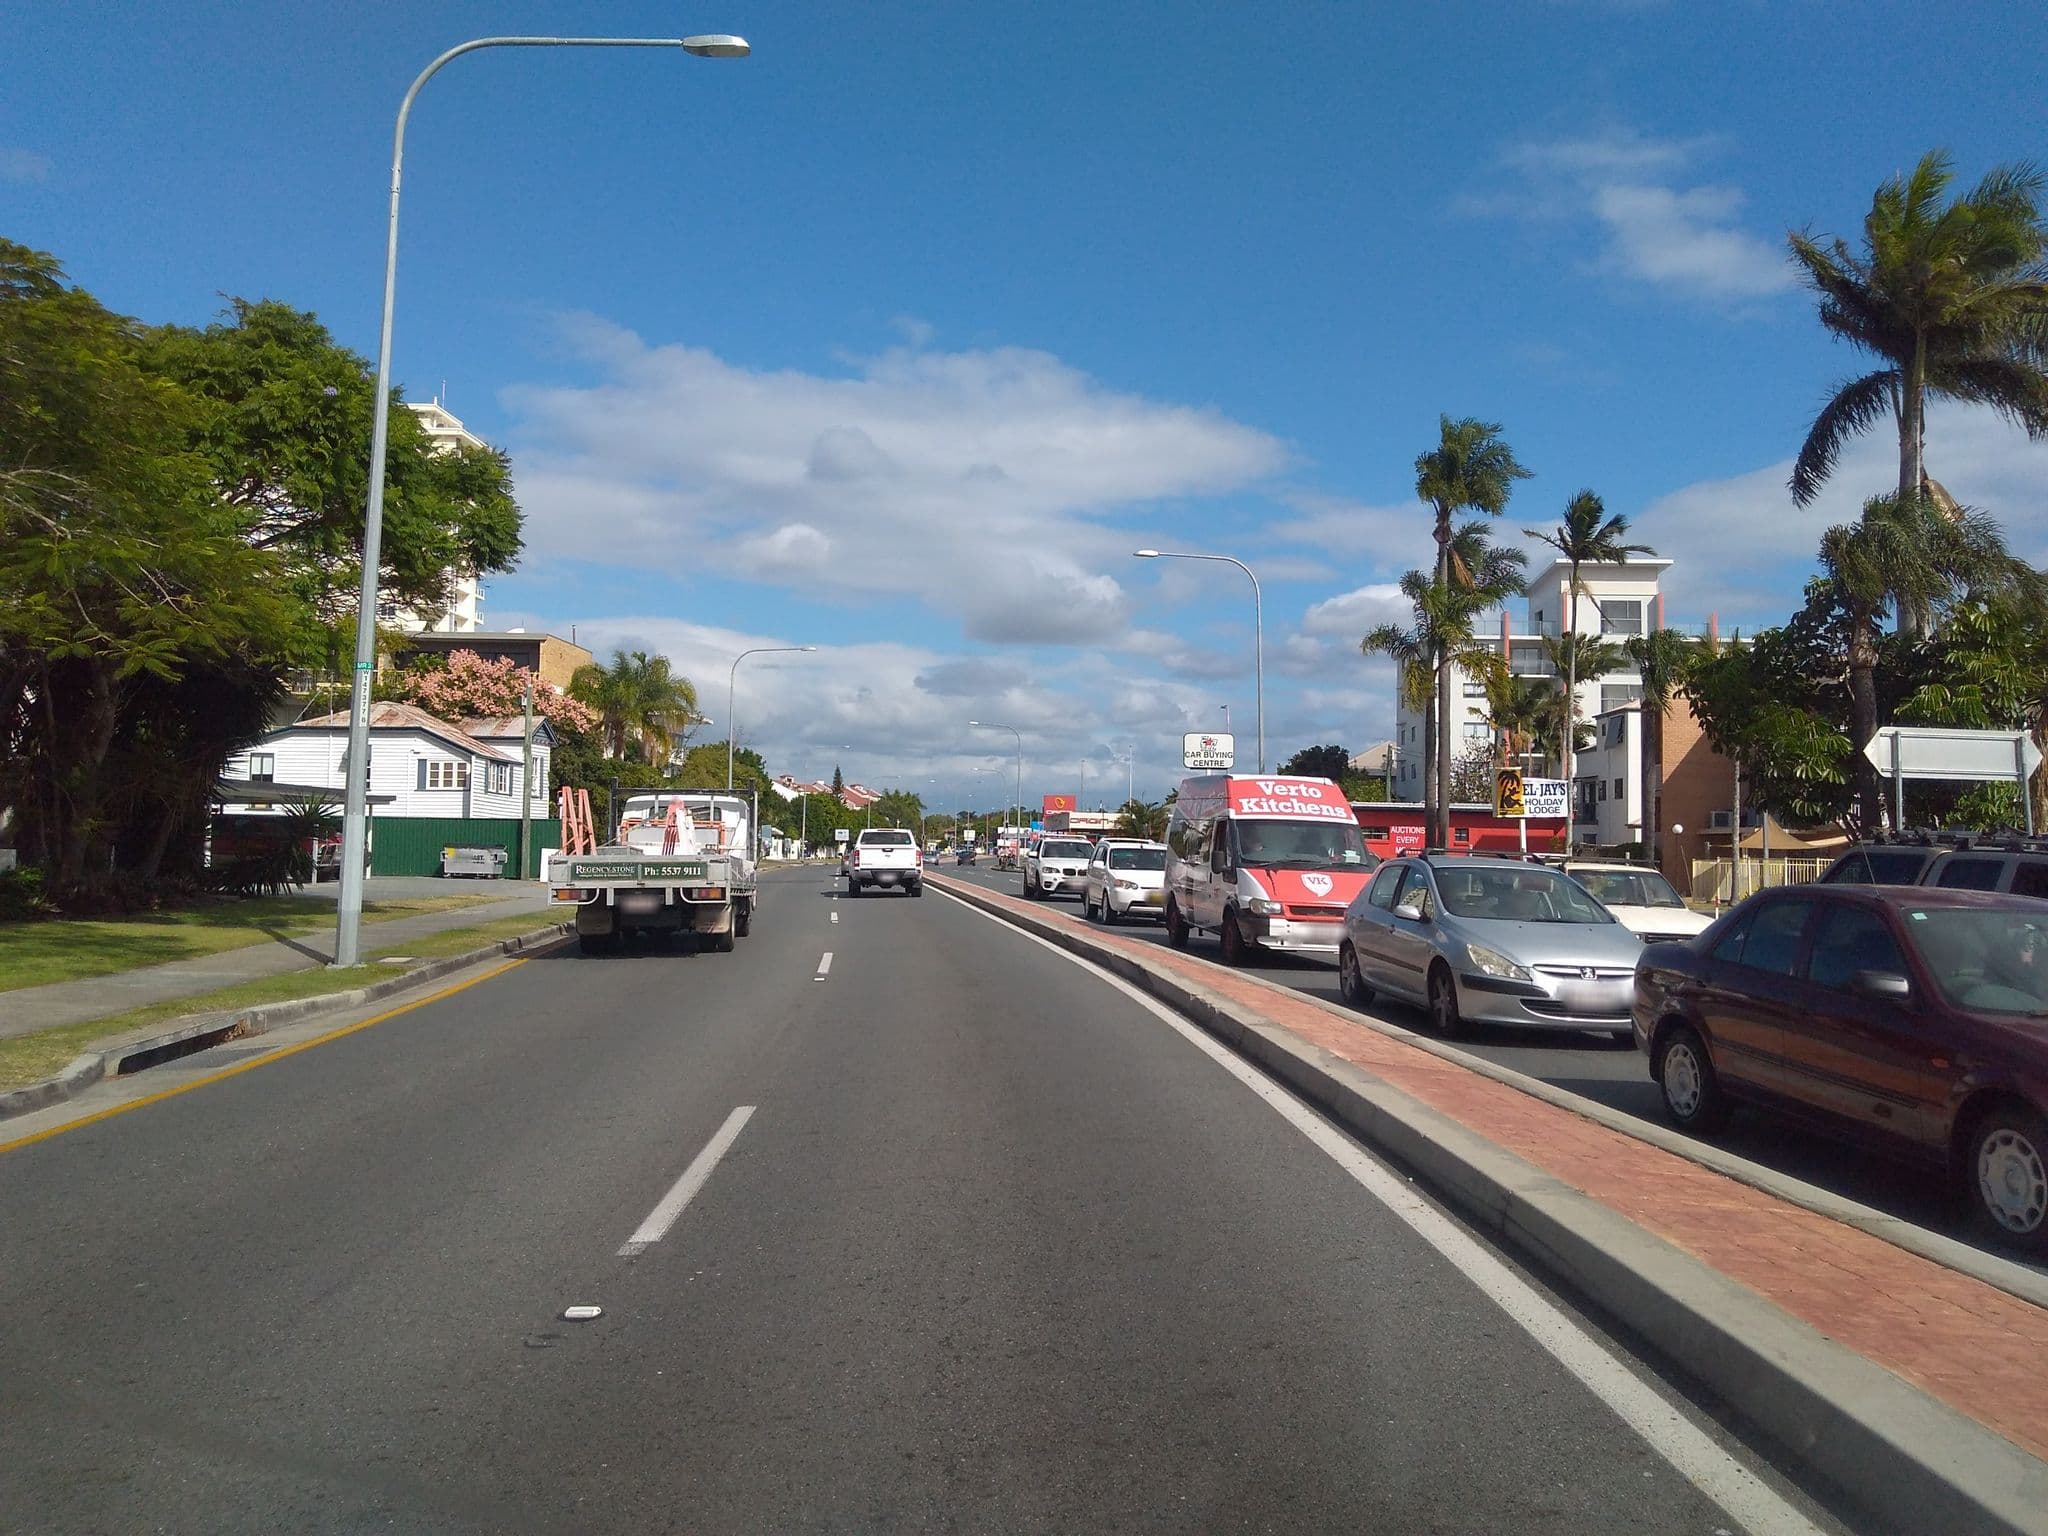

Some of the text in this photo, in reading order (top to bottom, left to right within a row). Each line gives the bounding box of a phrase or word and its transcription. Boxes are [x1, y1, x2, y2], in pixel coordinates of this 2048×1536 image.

[1184, 751, 1233, 759] CAR BUYING
[1193, 759, 1225, 767] CENTRE
[1257, 782, 1322, 799] Verto
[1524, 798, 1564, 806] HOLIDAY
[1239, 799, 1347, 818] Kitchens
[1528, 806, 1561, 814] LODGE
[1390, 825, 1426, 835] AUCTIONS
[1395, 836, 1420, 844] EVERY
[575, 865, 612, 875] REGENCY
[644, 867, 660, 876] Ph:
[661, 867, 682, 876] 5537
[683, 867, 701, 876] 9111
[1306, 876, 1329, 886] VK
